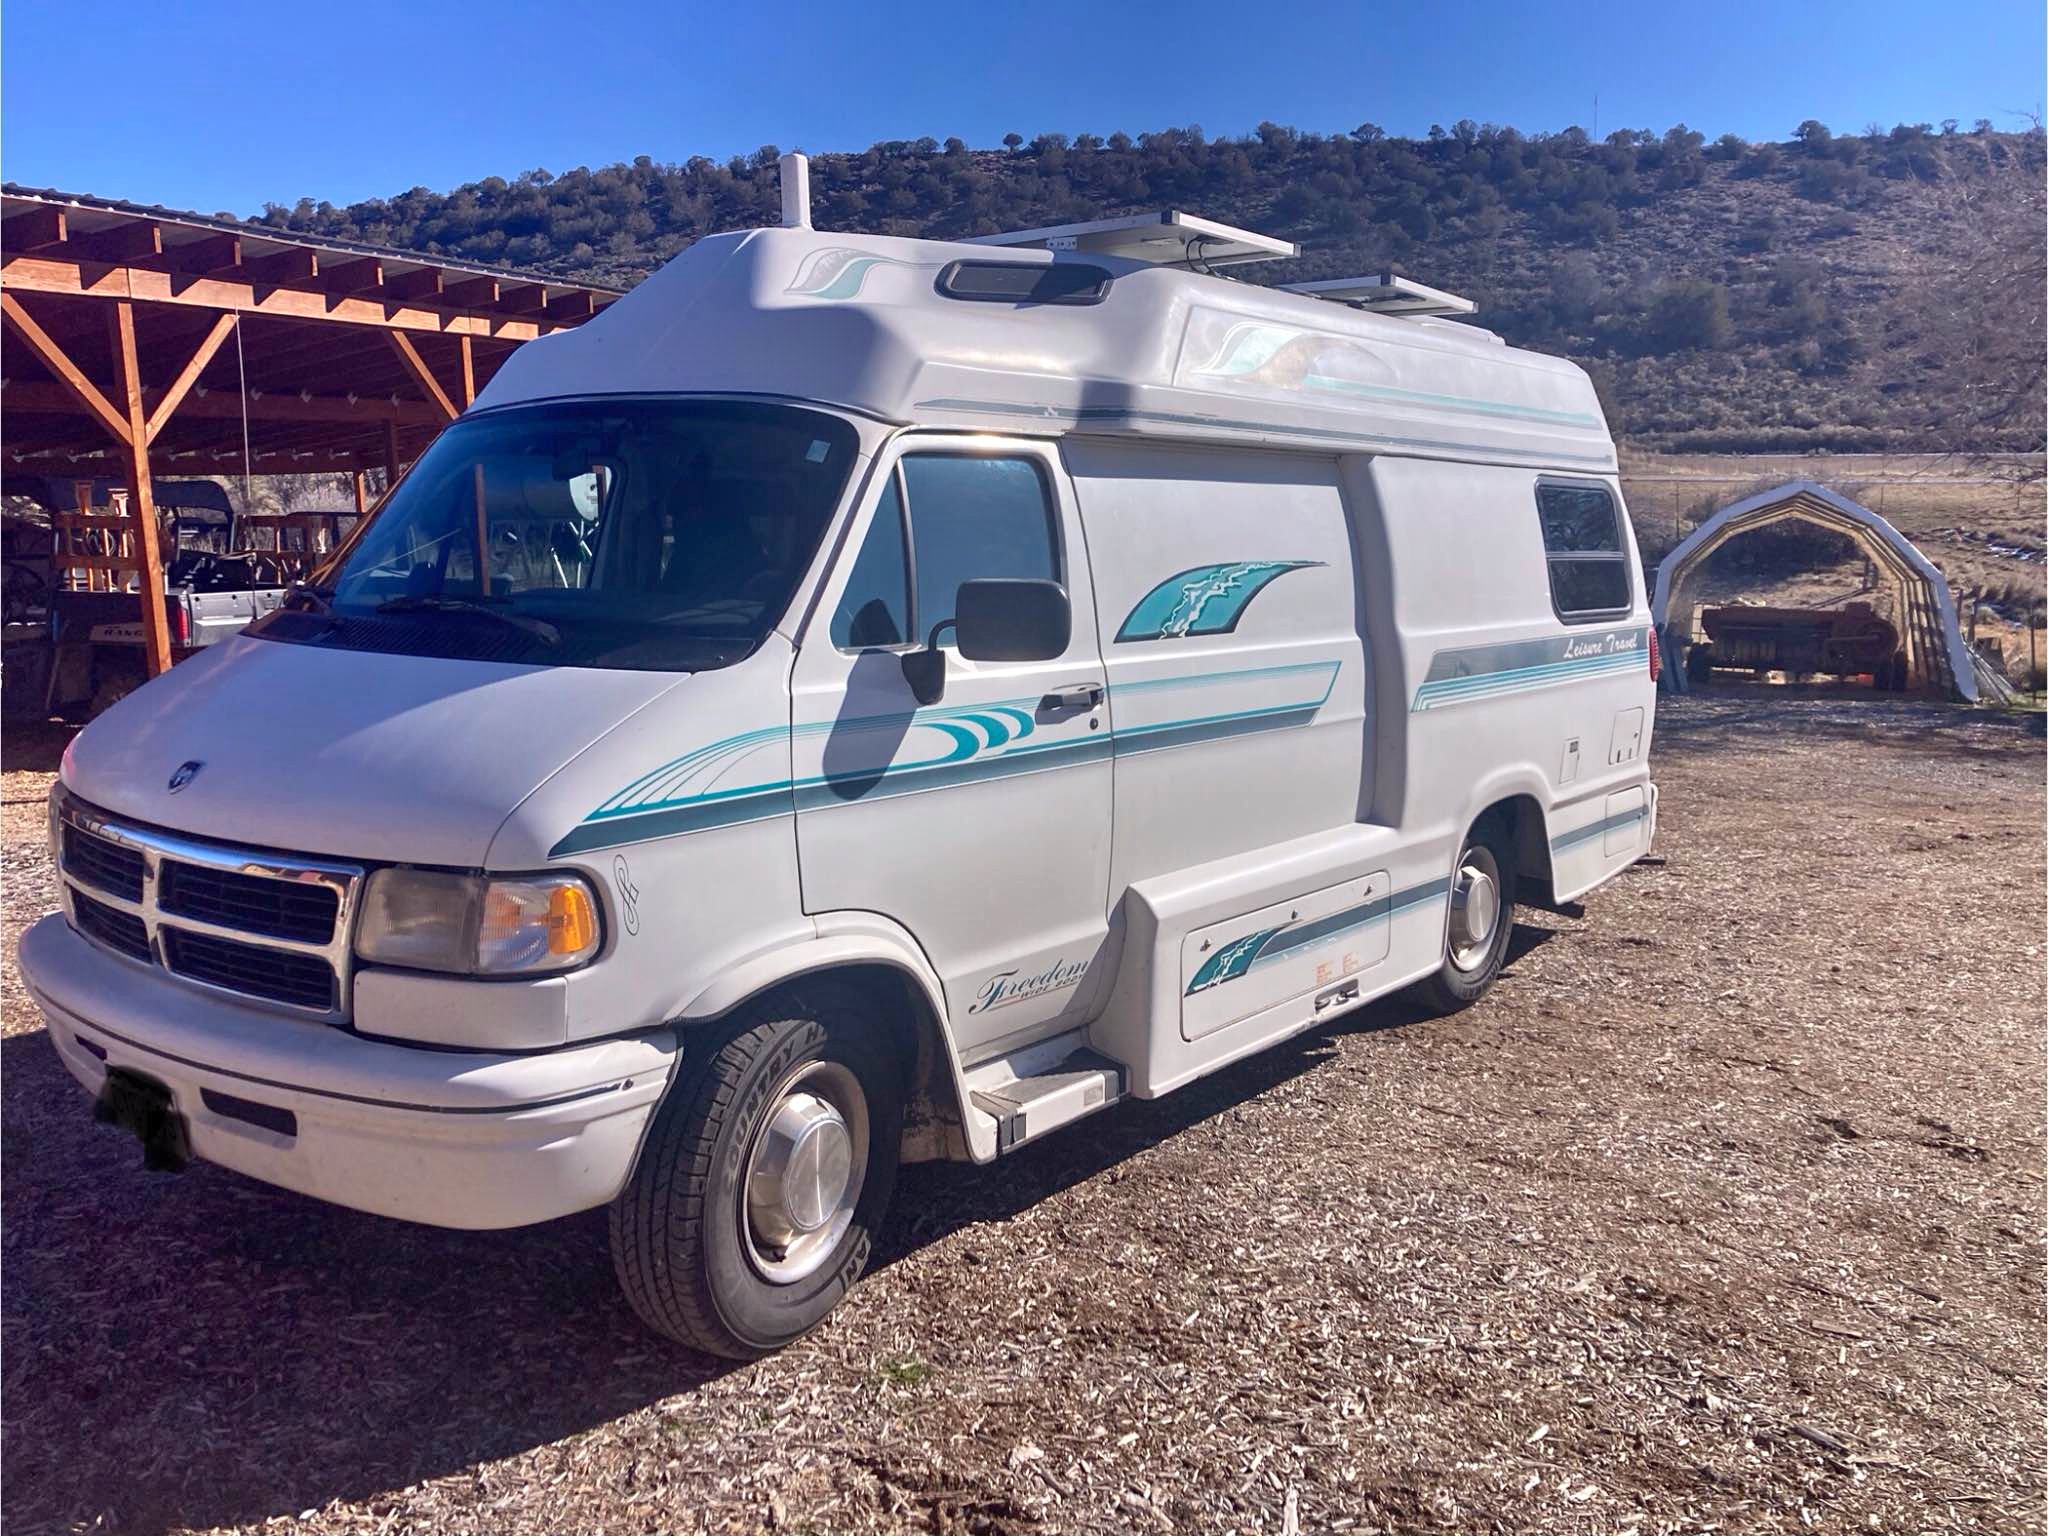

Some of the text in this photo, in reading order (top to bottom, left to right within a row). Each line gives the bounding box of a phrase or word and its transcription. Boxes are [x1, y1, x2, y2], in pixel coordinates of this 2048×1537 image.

[1563, 632, 1638, 659] Leisure Travel
[968, 957, 1089, 1015] Freedom
